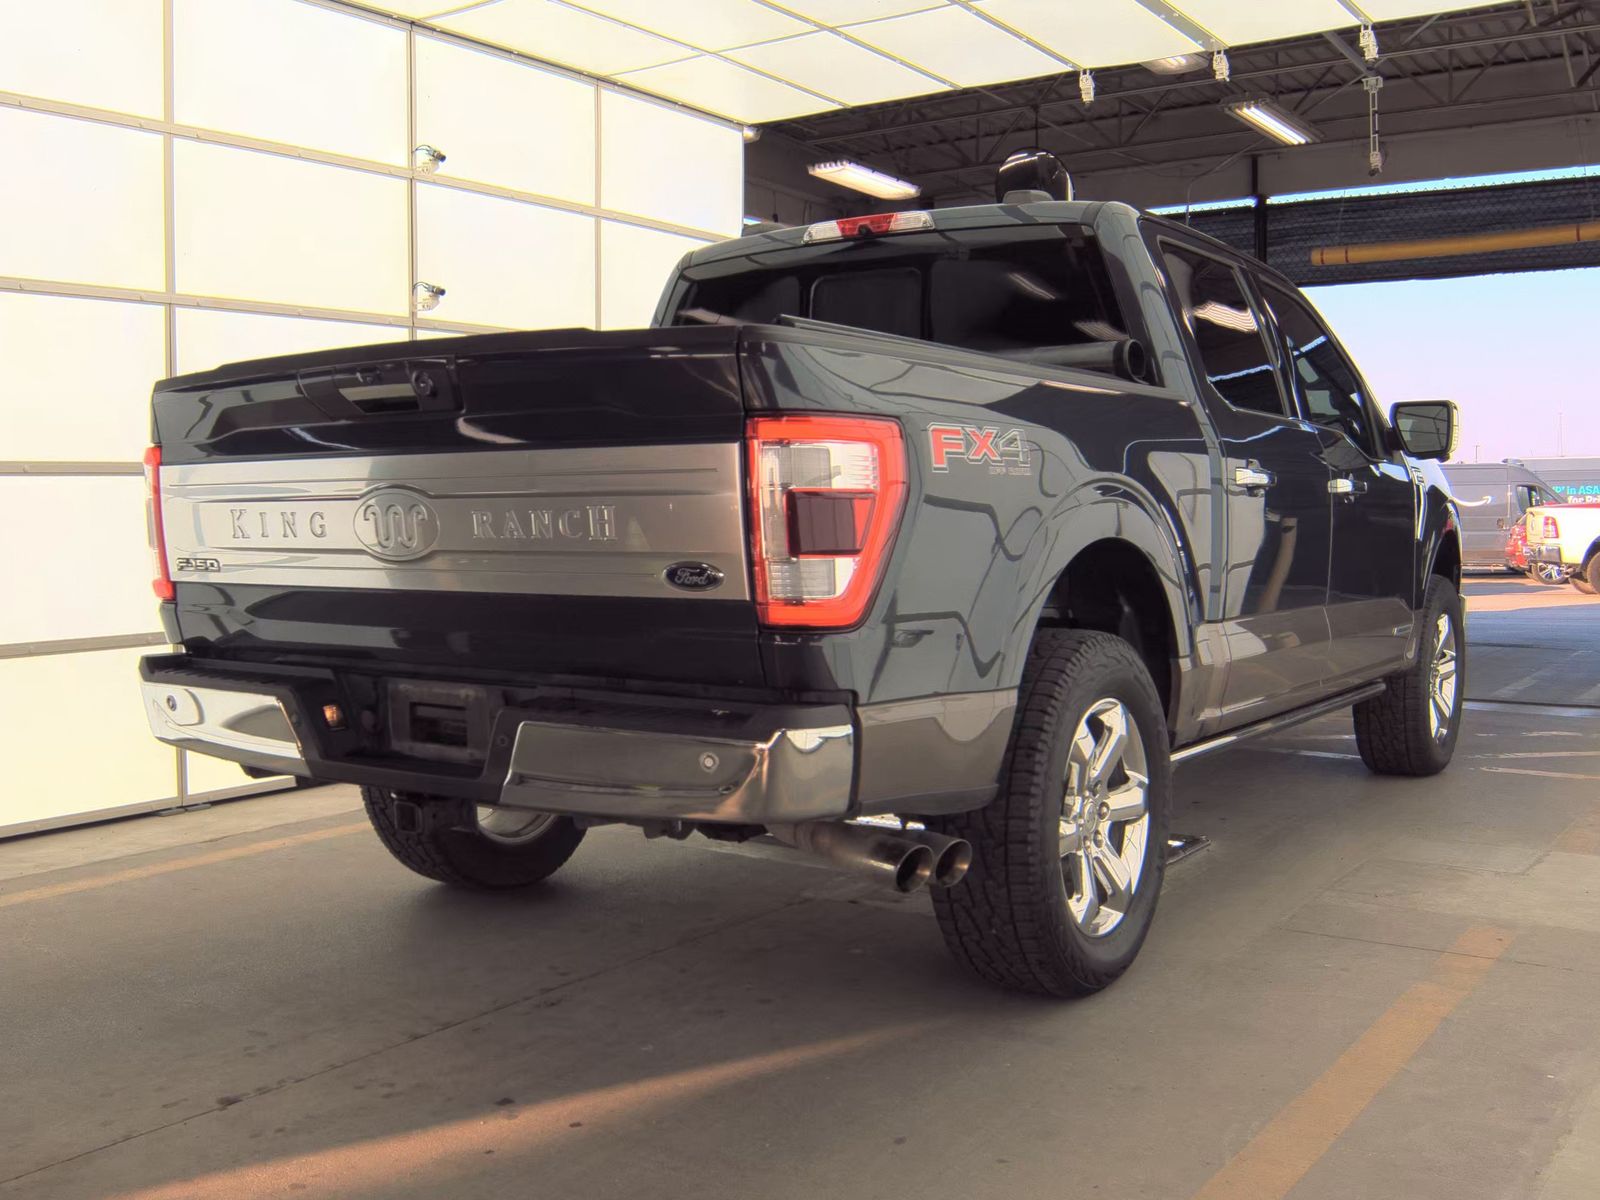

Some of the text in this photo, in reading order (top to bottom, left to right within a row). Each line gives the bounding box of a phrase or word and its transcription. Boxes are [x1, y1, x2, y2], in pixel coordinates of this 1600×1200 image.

[927, 422, 1031, 473] FX4
[230, 504, 619, 541] KING RANCH
[674, 567, 710, 585] Ford
